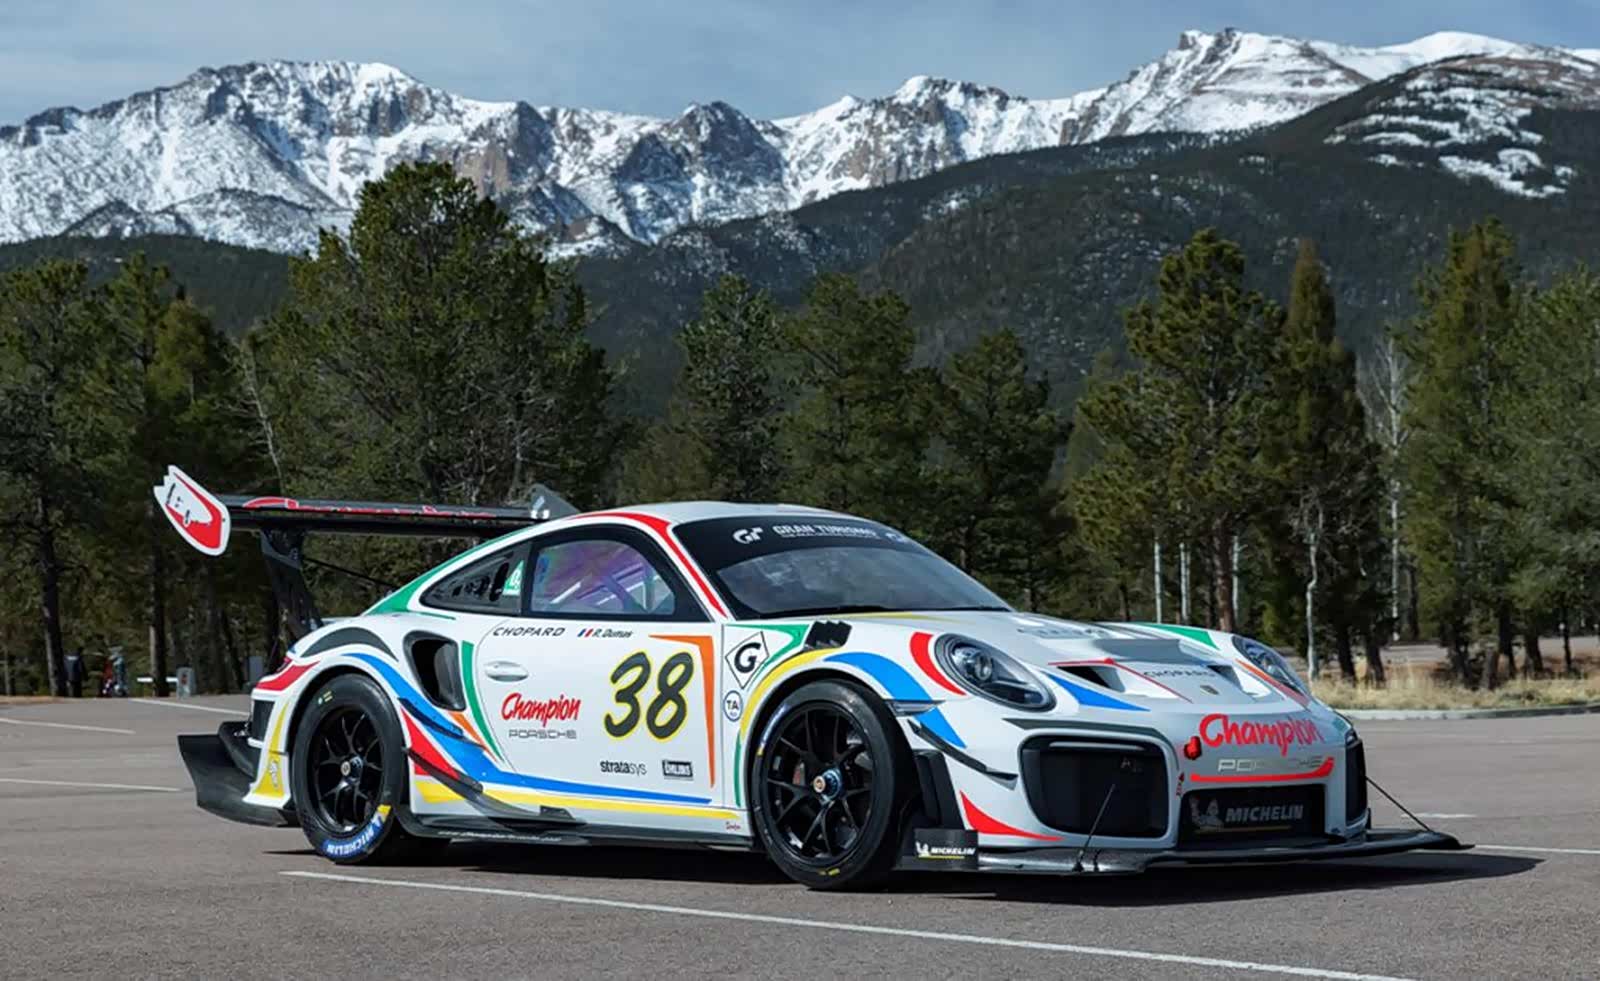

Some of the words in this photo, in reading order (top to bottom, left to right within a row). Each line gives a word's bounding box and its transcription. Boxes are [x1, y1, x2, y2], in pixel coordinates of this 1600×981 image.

[772, 525, 815, 535] GRAN
[493, 626, 566, 637] CHOPARD
[733, 641, 762, 673] G
[603, 650, 695, 741] 38
[501, 692, 582, 728] Champion
[508, 728, 578, 740] PORSCHE
[1199, 713, 1326, 756] Champion
[599, 760, 648, 776] stratasys
[1225, 803, 1305, 823] MICHELIN
